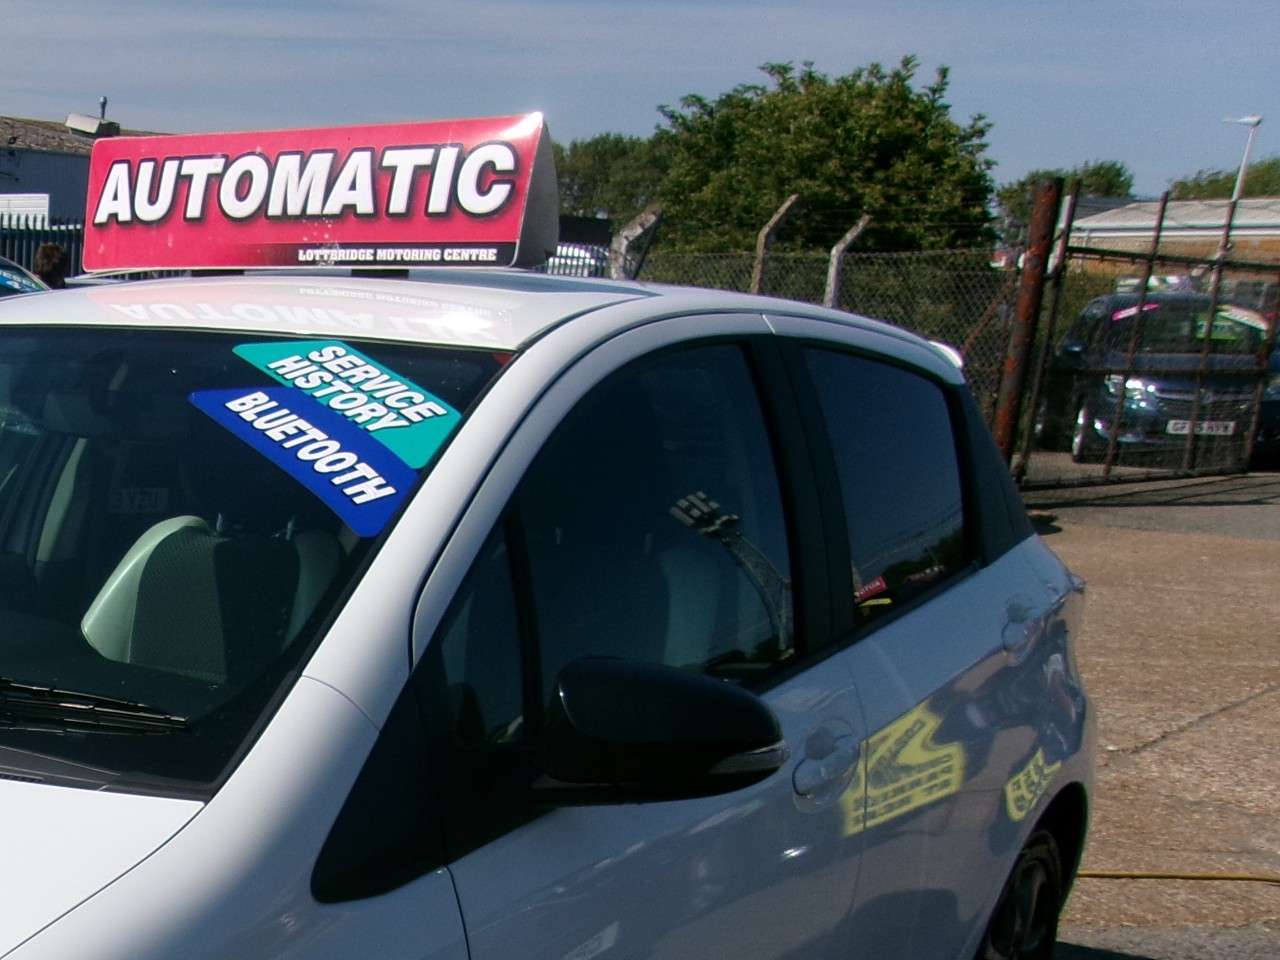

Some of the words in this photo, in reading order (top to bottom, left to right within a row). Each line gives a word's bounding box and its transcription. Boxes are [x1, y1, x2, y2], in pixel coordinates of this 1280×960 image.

[93, 143, 517, 225] AUTOMATIC
[297, 248, 374, 262] LOTTBRIDGE
[376, 248, 441, 262] MOTORING
[443, 247, 498, 262] CENTRE
[267, 355, 410, 432] HISTORY
[308, 346, 448, 423] SERVICE
[224, 391, 397, 505] BLUETOOTH
